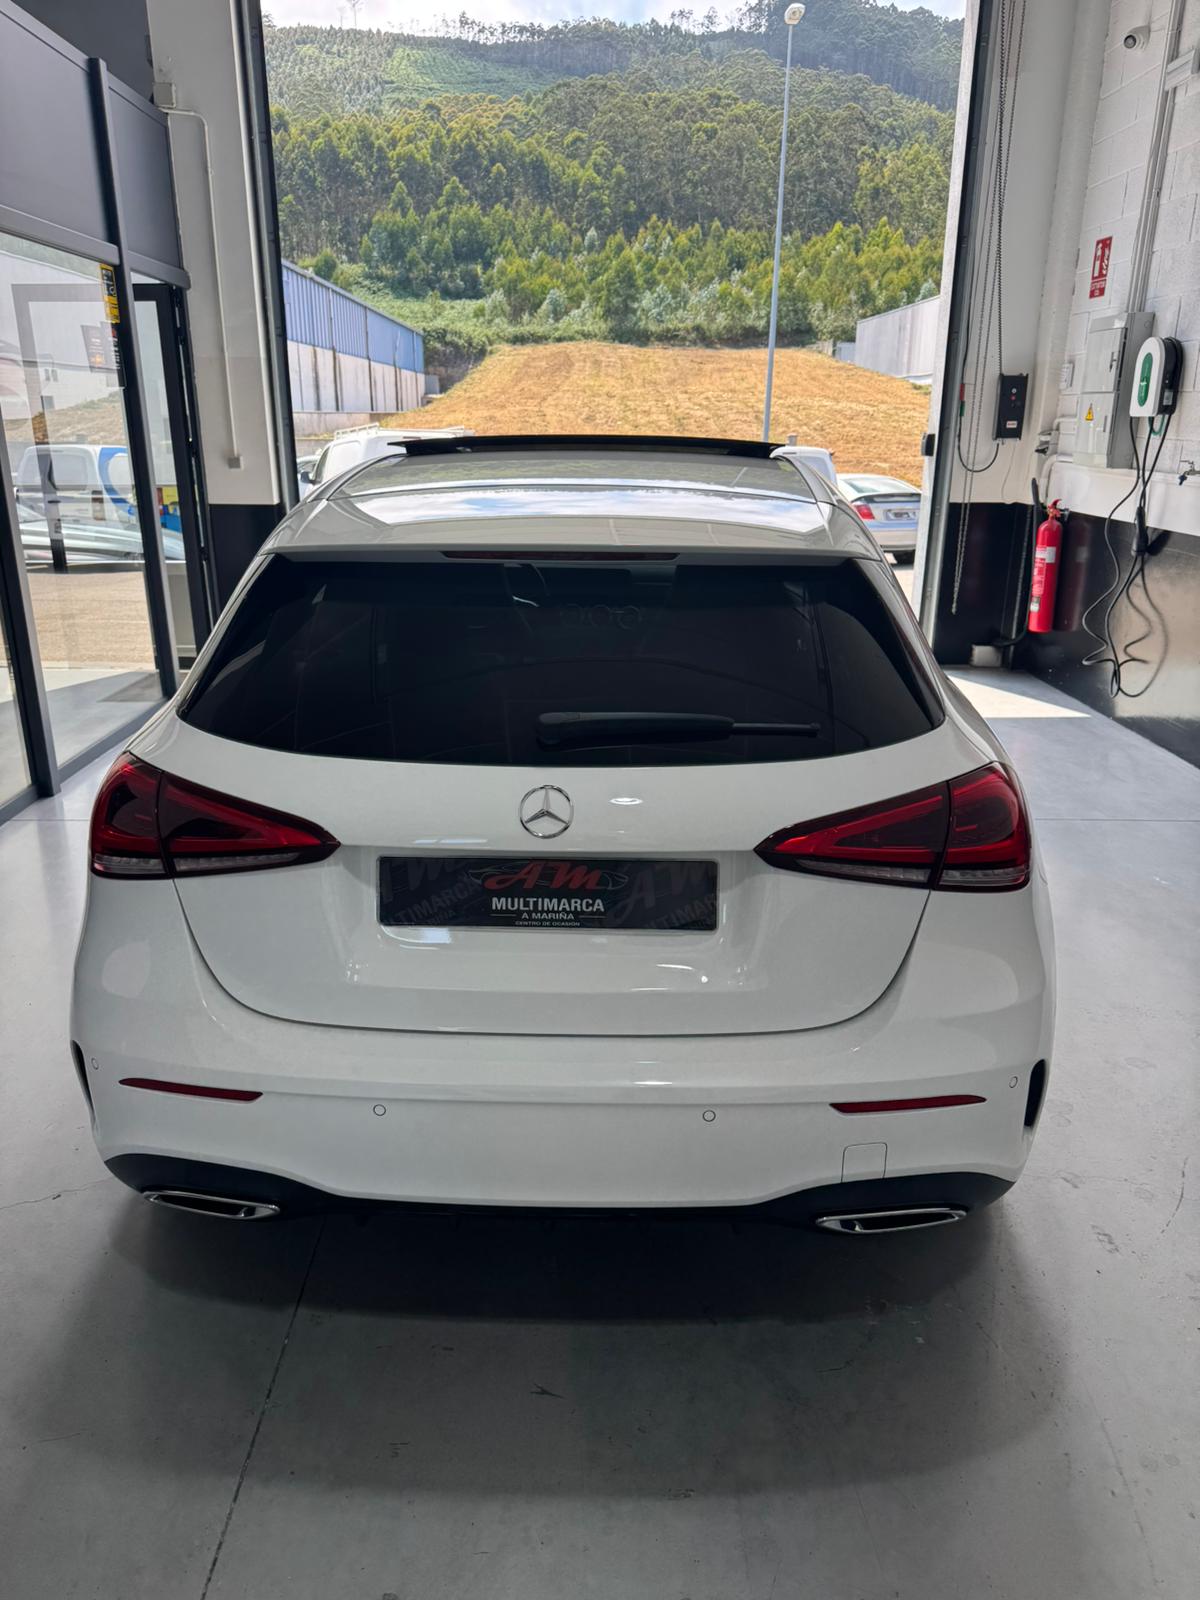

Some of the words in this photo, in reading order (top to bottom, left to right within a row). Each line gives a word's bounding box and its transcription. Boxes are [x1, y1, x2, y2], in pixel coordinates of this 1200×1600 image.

[491, 897, 604, 912] MULTIMARCA
[521, 912, 529, 920] A
[532, 911, 575, 920] MARIÑA
